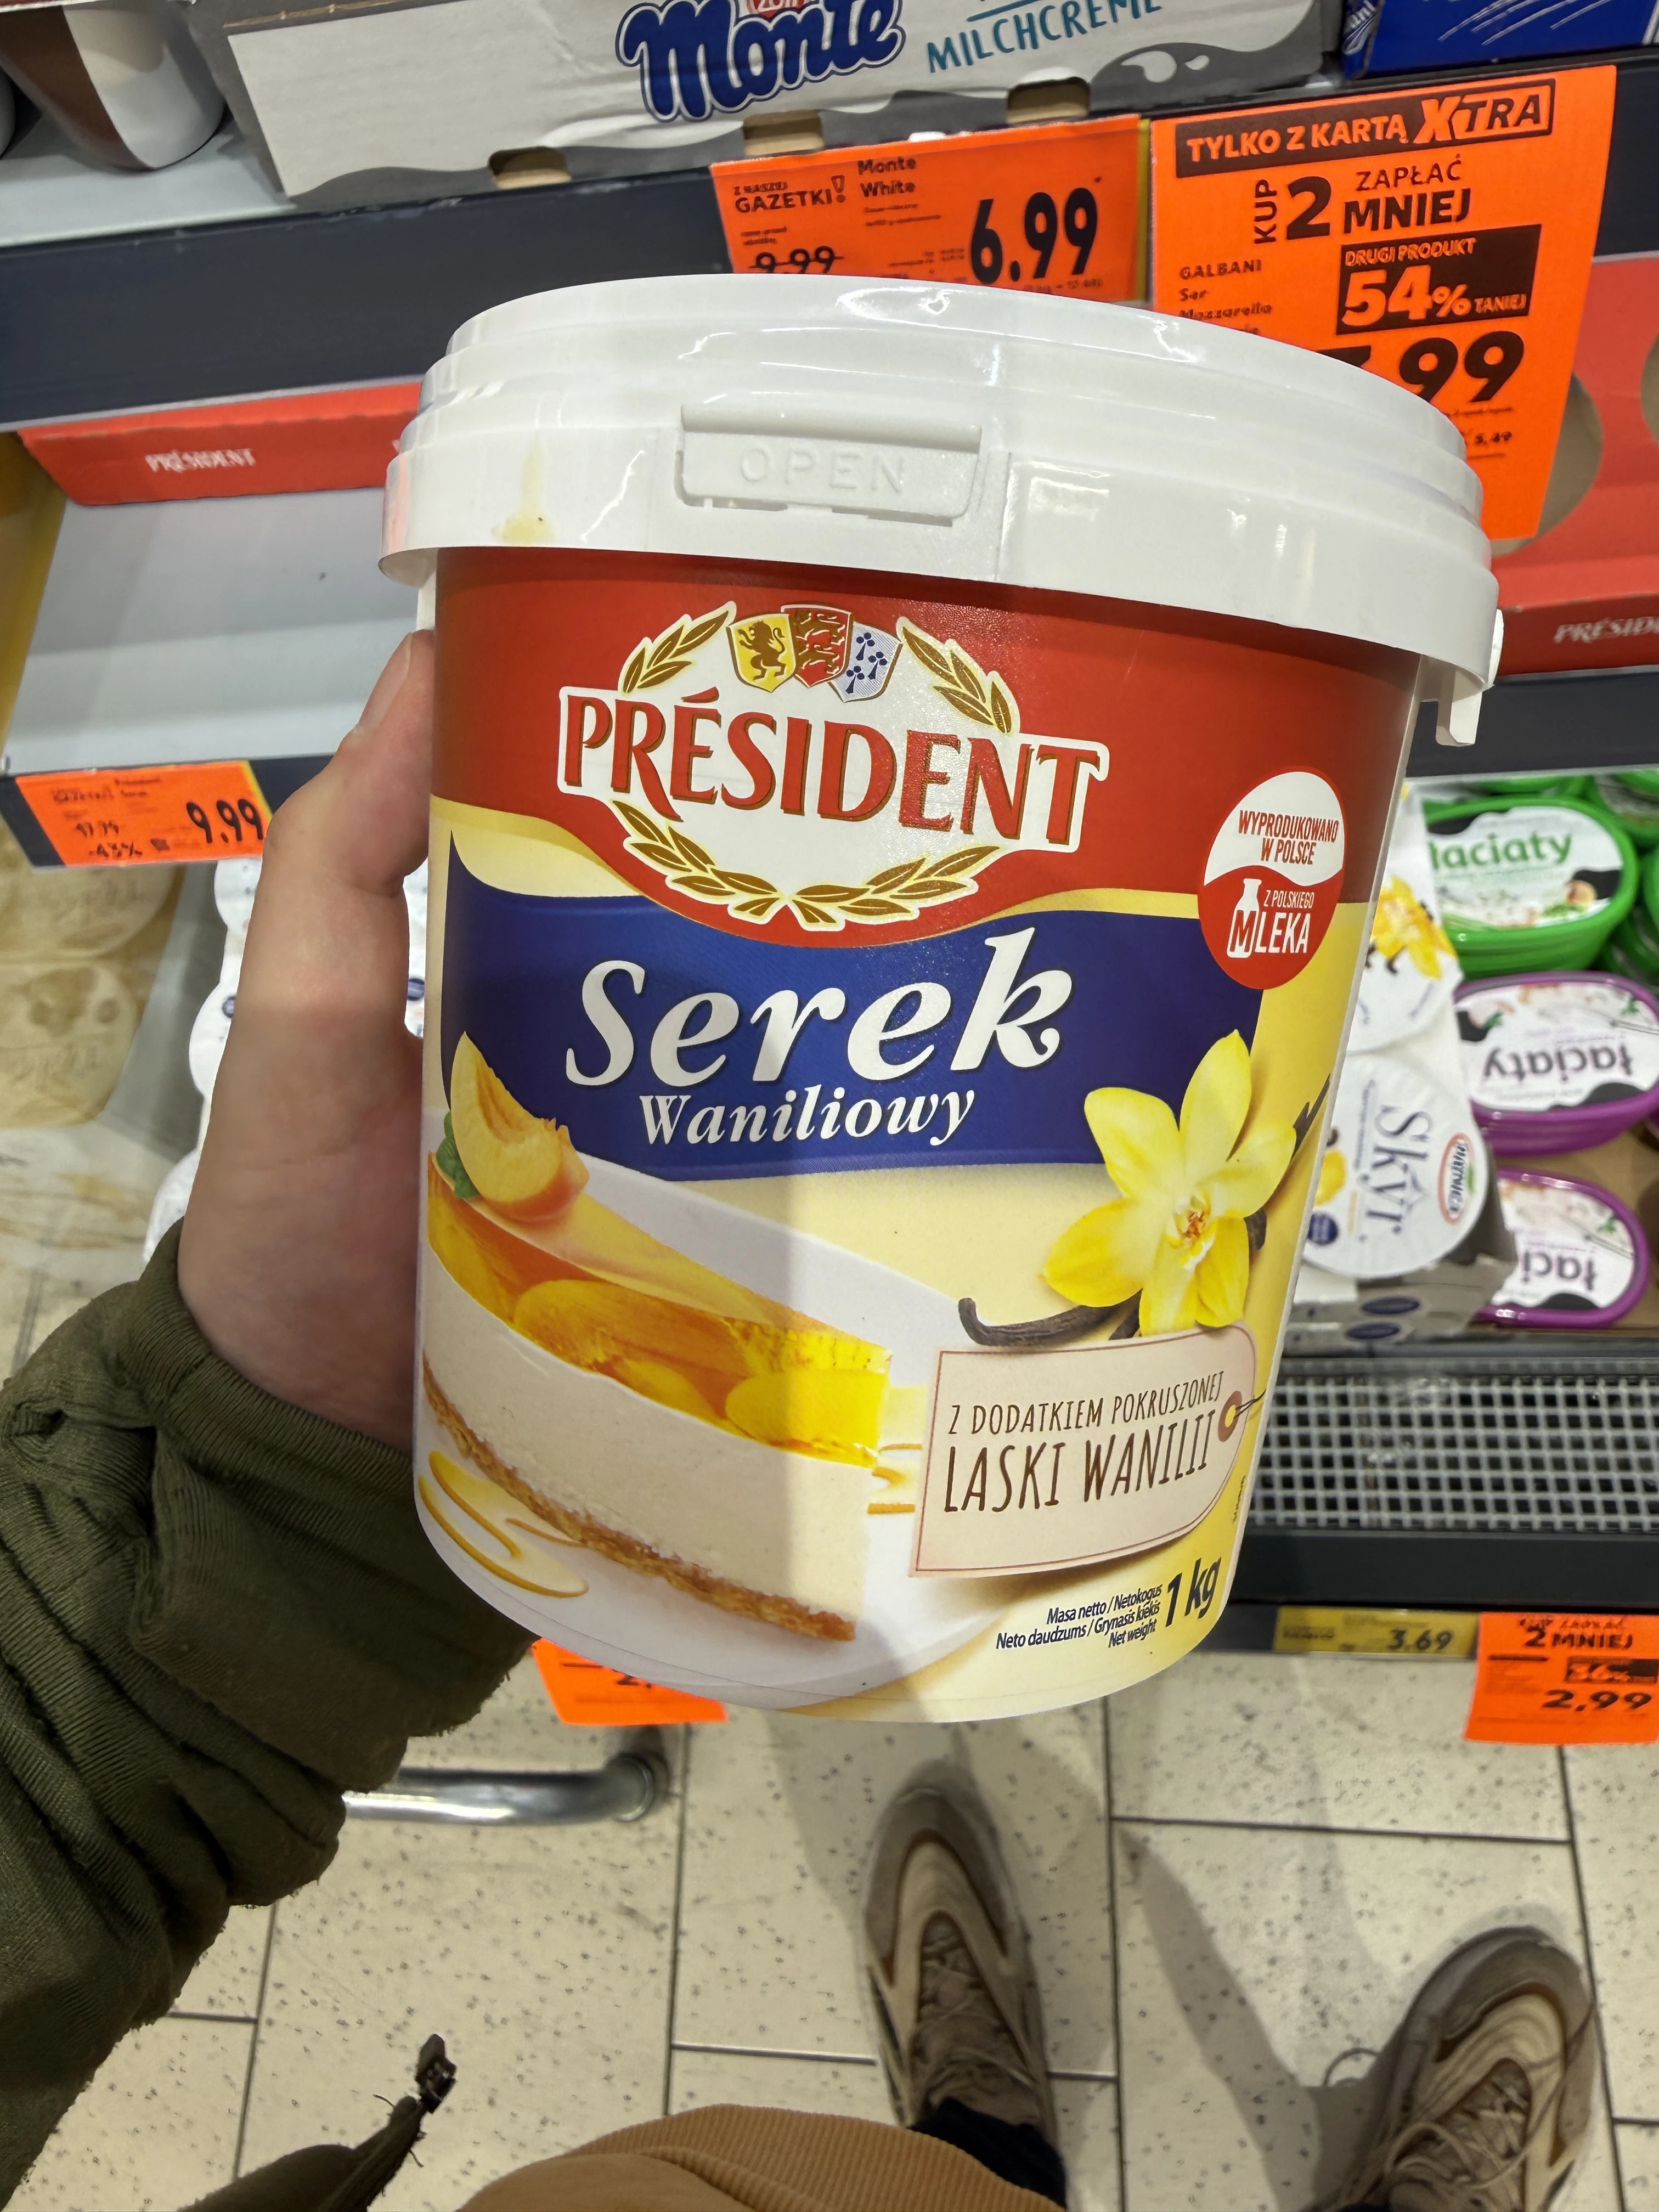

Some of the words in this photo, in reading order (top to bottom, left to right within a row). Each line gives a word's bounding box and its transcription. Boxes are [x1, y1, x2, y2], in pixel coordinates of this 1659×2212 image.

[616, 0, 906, 122] Monte
[1187, 131, 1280, 162] TYLKO
[1286, 126, 1305, 150] Z
[1311, 114, 1409, 147] KARTĄ
[1414, 94, 1542, 144] XTRA
[857, 156, 916, 176] Monte
[1356, 153, 1462, 191] ZAPŁAĆ
[860, 180, 915, 198] White
[1286, 176, 1331, 240] 2
[1254, 179, 1277, 244] KUP
[1344, 188, 1471, 234] MNIEJ
[970, 187, 1098, 284] 6.99
[1345, 245, 1396, 266] DRUGI
[1398, 238, 1477, 261] PRODUKT
[1180, 259, 1261, 279] GALBANI
[1180, 288, 1209, 301] Ser
[1341, 264, 1471, 326] 54%
[1474, 294, 1527, 313] TANIEJ
[741, 448, 904, 493] OPEN
[564, 687, 1101, 845] PRÉSIDENT
[186, 798, 264, 843] 9.99
[1238, 810, 1339, 842] WYPRODUKOWANO
[1261, 838, 1275, 861] W
[1274, 839, 1316, 865] POLSCE
[1263, 890, 1271, 907] Z
[1273, 890, 1314, 909] POLSKIEGO
[1229, 910, 1311, 953] MLEKA
[565, 926, 1073, 1086] Serek
[639, 1084, 975, 1146] Waniliowy
[1357, 1103, 1433, 1235] Skyr
[1520, 1250, 1599, 1291] łaci
[949, 1405, 961, 1434] Z
[971, 1397, 1104, 1434] DODATKIEM
[1111, 1370, 1224, 1425] POKRUSZONEJ
[944, 1442, 1065, 1513] LASKI
[1084, 1409, 1216, 1502] WANILII
[1046, 1607, 1076, 1624] Masa
[1078, 1602, 1107, 1619] netto
[1113, 1584, 1163, 1611] Netokogus
[1165, 1573, 1182, 1627] 1
[1184, 1557, 1222, 1618] kg
[996, 1632, 1025, 1649] Neto
[1028, 1624, 1086, 1645] daudzums
[1094, 1609, 1135, 1635] Grynasis
[1108, 1631, 1126, 1647] Net
[1127, 1618, 1157, 1640] weight
[1390, 1629, 1454, 1651] 3.69
[1525, 1626, 1546, 1647] 2
[1552, 1633, 1633, 1649] MNIEJ
[1541, 1689, 1652, 1711] 2.99
